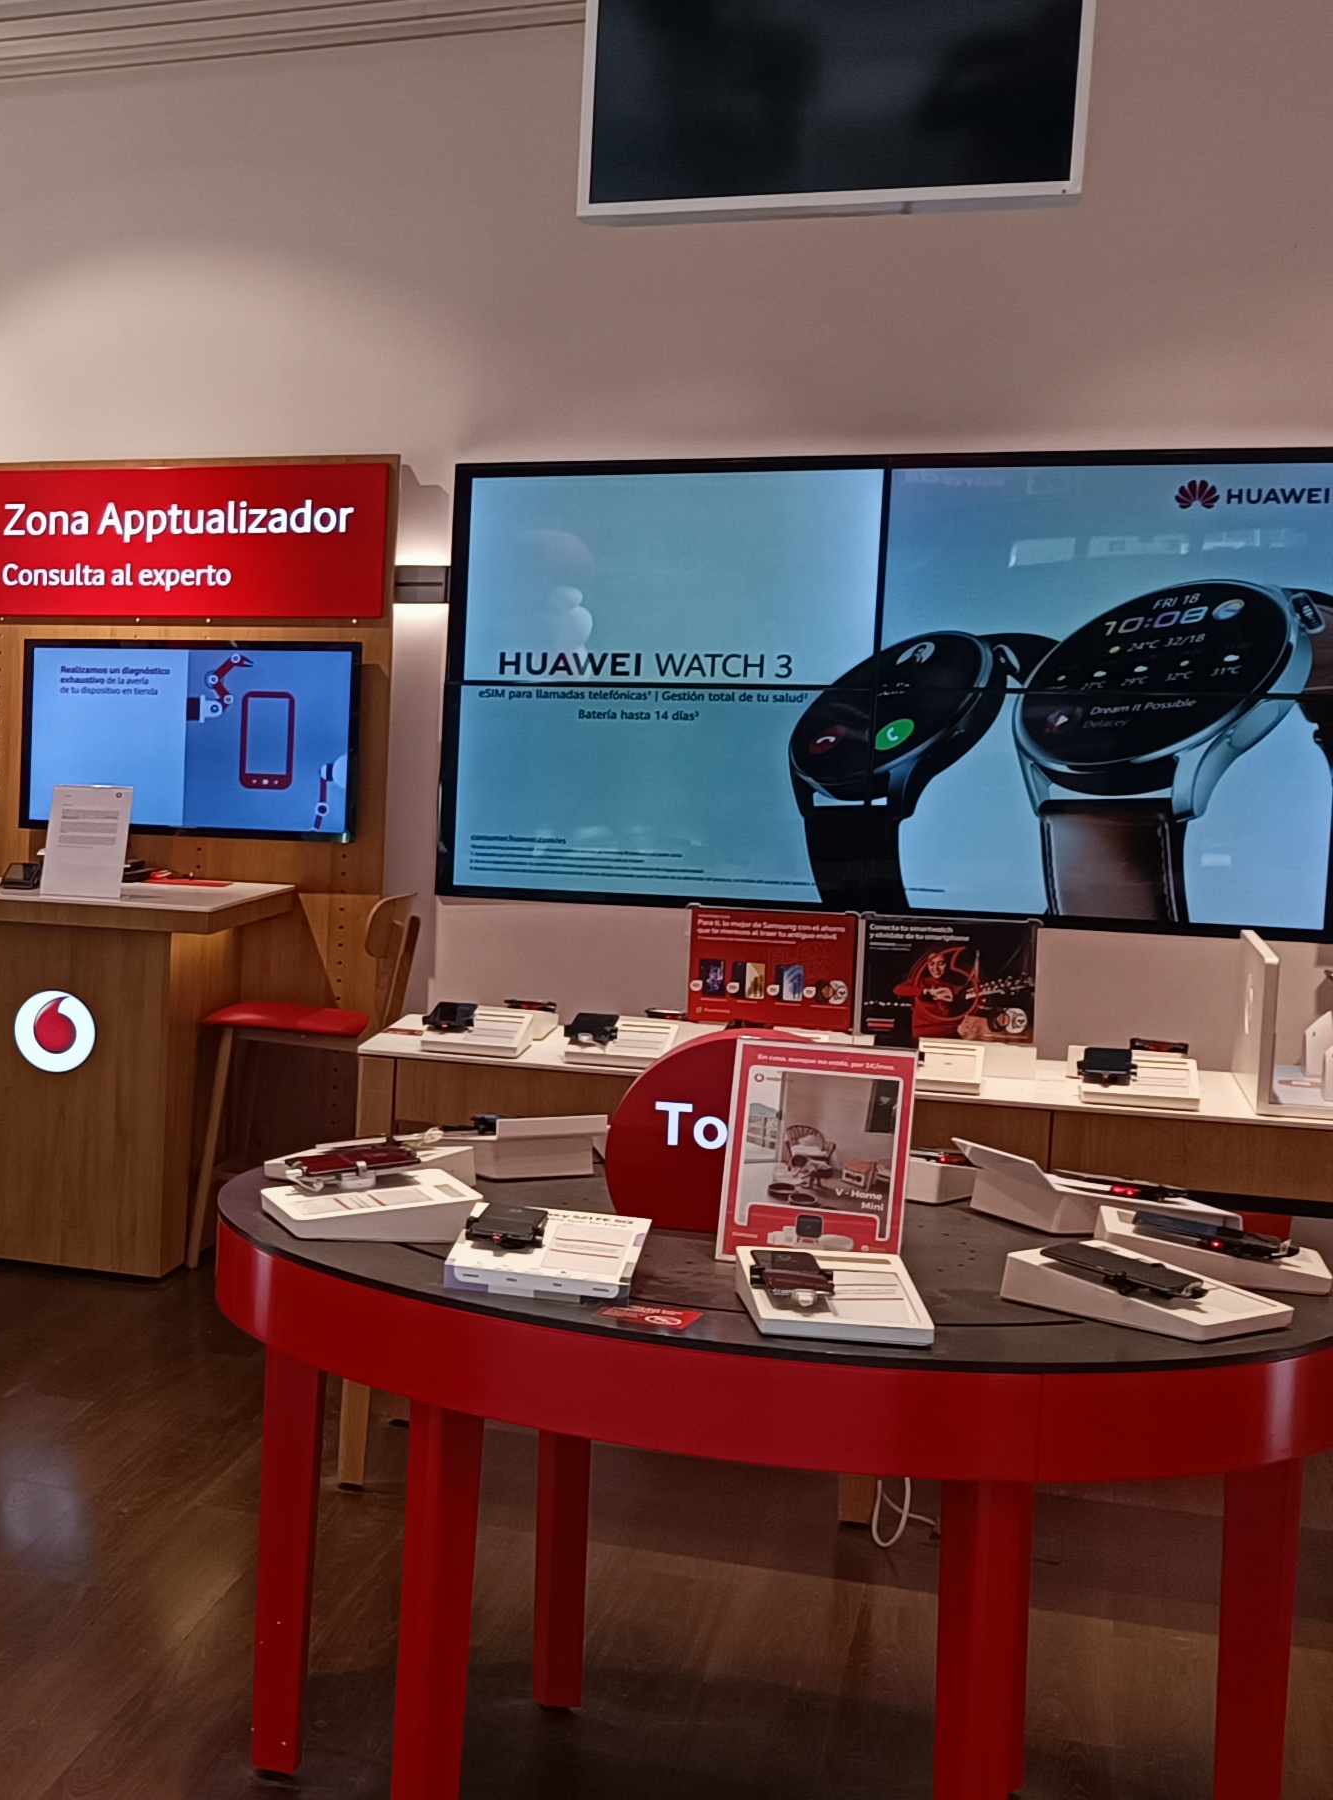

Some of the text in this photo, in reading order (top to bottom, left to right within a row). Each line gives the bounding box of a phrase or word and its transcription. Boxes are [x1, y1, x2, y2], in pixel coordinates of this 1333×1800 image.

[1226, 488, 1330, 504] HUAWEI
[3, 499, 354, 544] Zona Apptualizador
[2, 562, 231, 592] Consulta al experto
[1153, 593, 1200, 610] FRI 18
[1104, 606, 1208, 637] 10:08
[1163, 633, 1206, 647] 32/18
[61, 666, 107, 674] Realizamos
[122, 667, 170, 677] diagnóstico
[499, 652, 793, 679] HUAWEI WATCH 3
[578, 708, 617, 721] Batería
[620, 709, 650, 721] hasta
[655, 710, 668, 721] 14
[1091, 703, 1129, 716] Dream
[1144, 698, 1197, 711] Possible
[835, 1187, 844, 1196] V
[851, 1189, 883, 1201] Home
[861, 1202, 884, 1211] Mini
